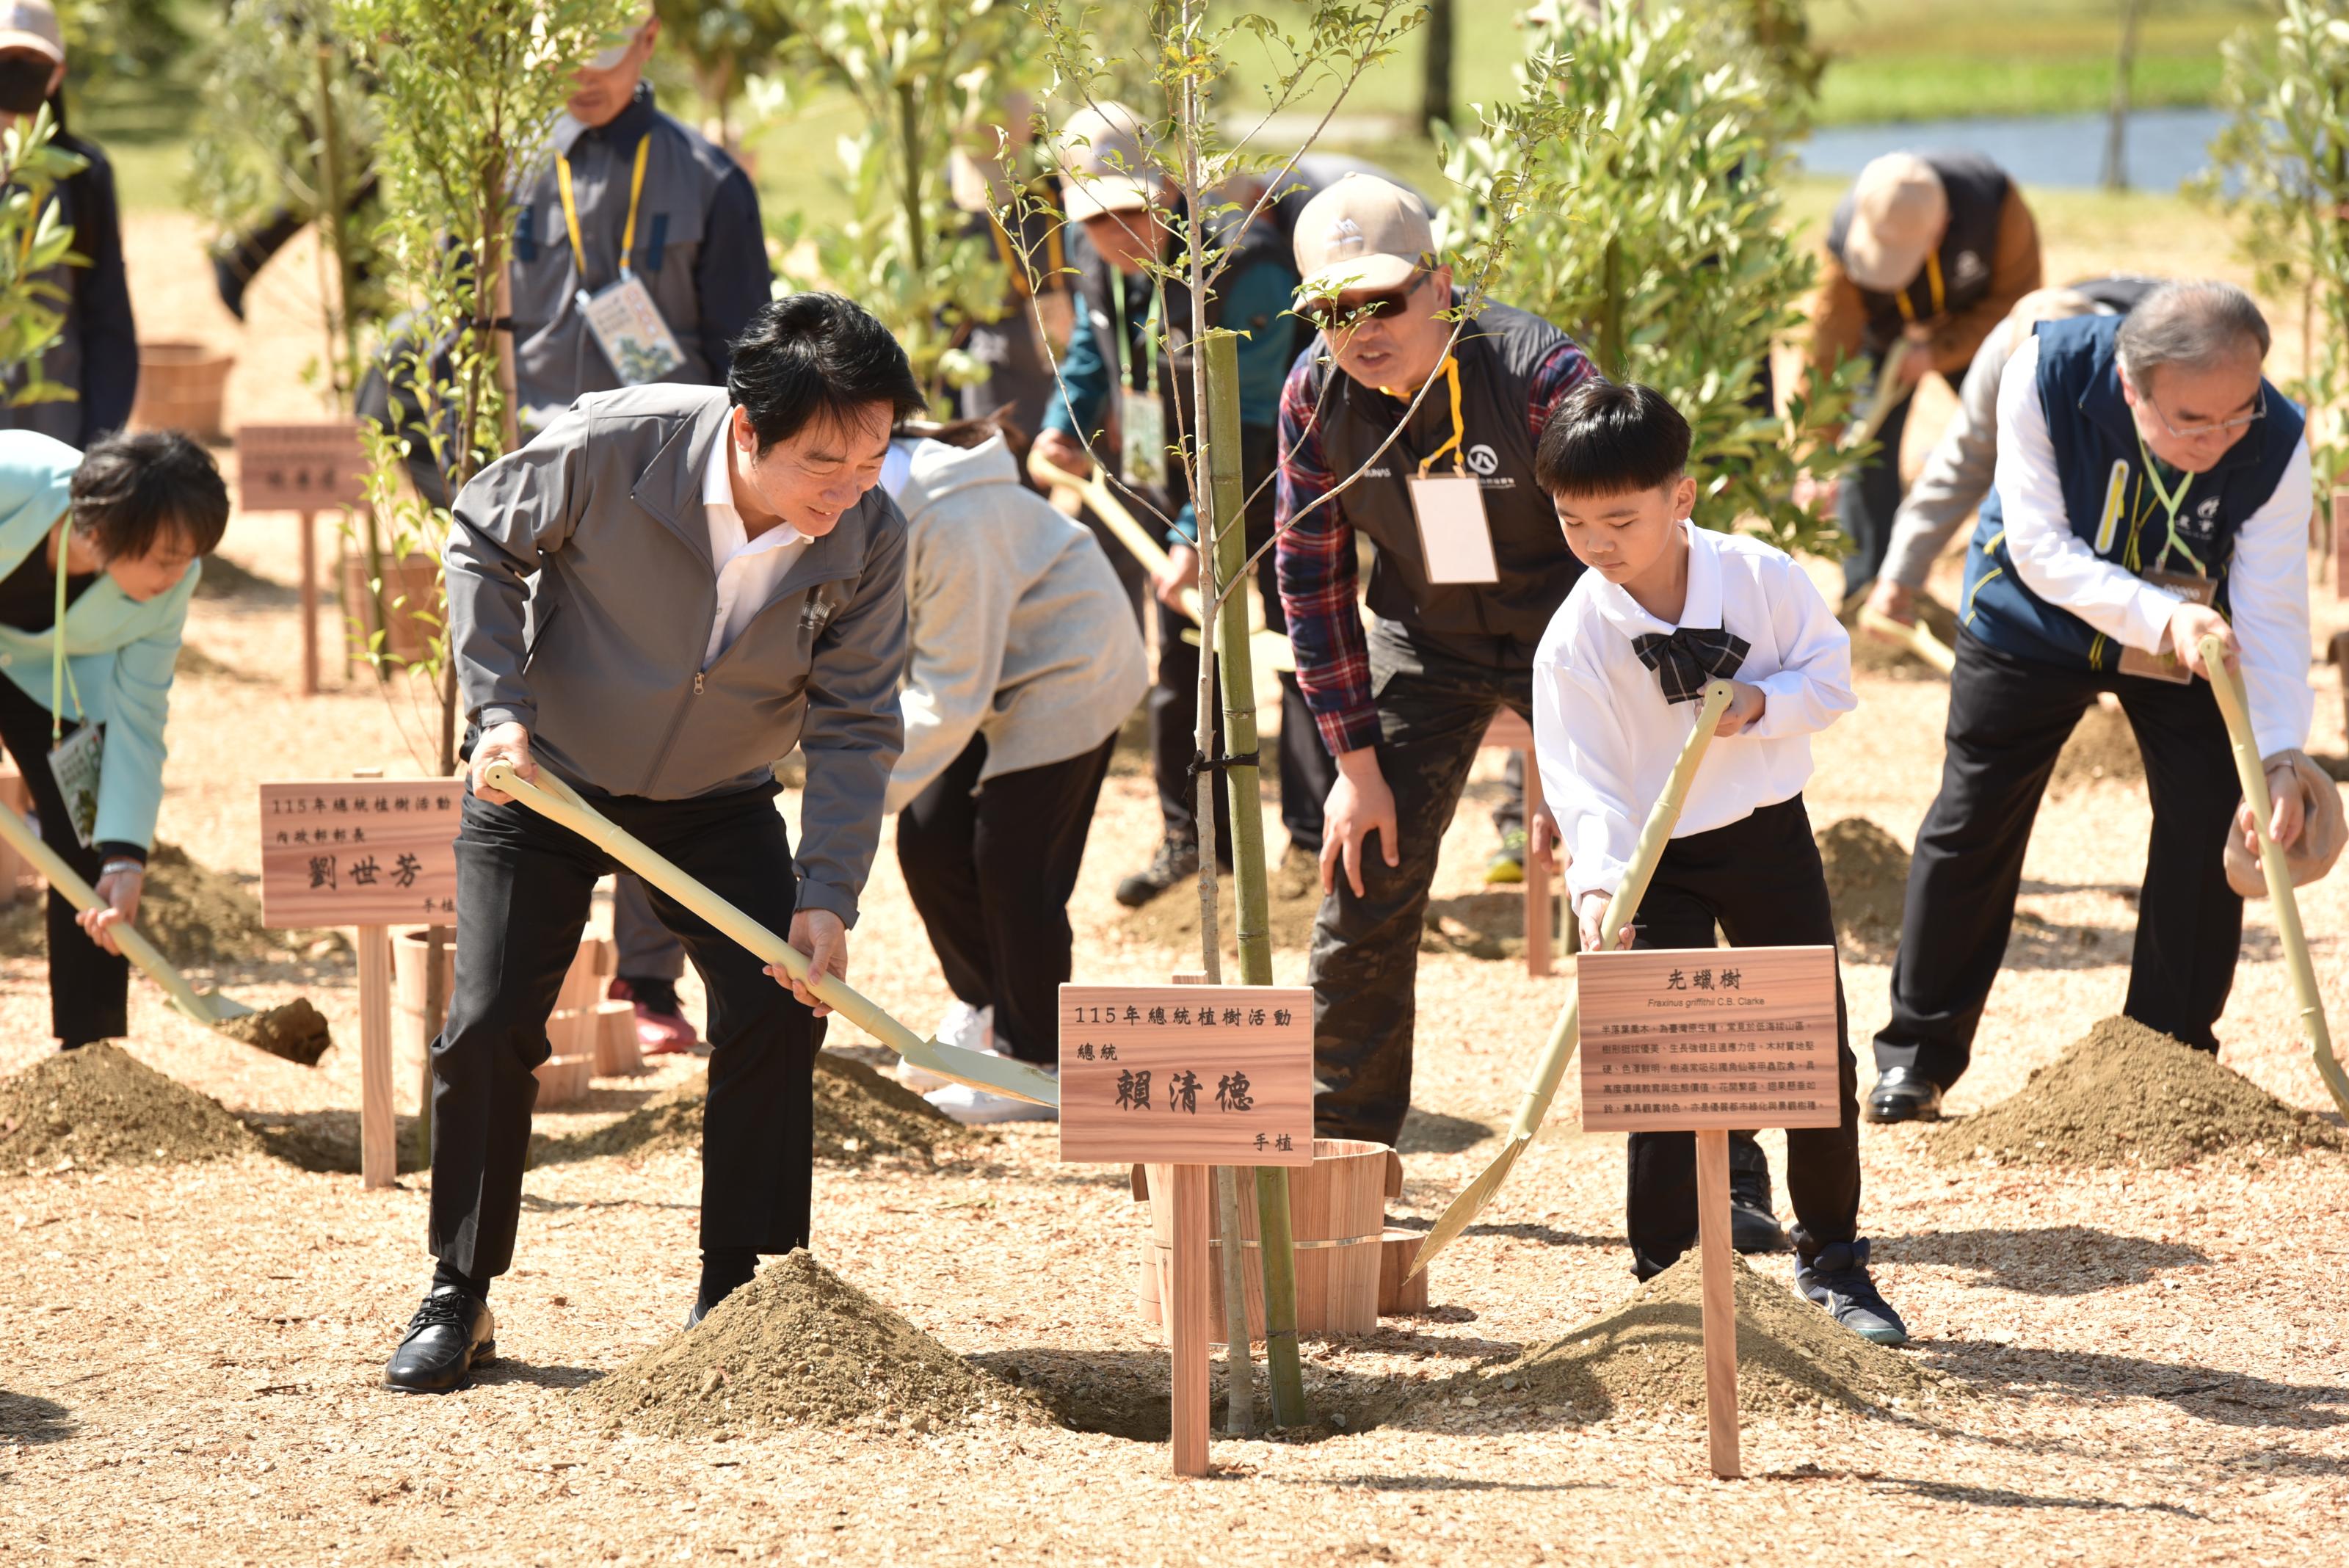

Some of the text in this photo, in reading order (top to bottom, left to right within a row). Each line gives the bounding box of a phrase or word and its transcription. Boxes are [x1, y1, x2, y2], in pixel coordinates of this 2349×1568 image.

[272, 796, 451, 815] 115年總統植樹活動
[276, 826, 366, 844] 內政部部長
[308, 852, 422, 890] 劉世芳
[422, 897, 456, 913] 手植
[1666, 968, 1742, 991] 光蠟樹
[1647, 996, 1765, 1008] Fraxinus griffithii C.B. Clarke
[1075, 1005, 1292, 1027] 115年總統植樹活動
[1077, 1042, 1118, 1061] 總統
[1115, 1069, 1255, 1115] 賴清德
[1252, 1133, 1293, 1153] 手植
